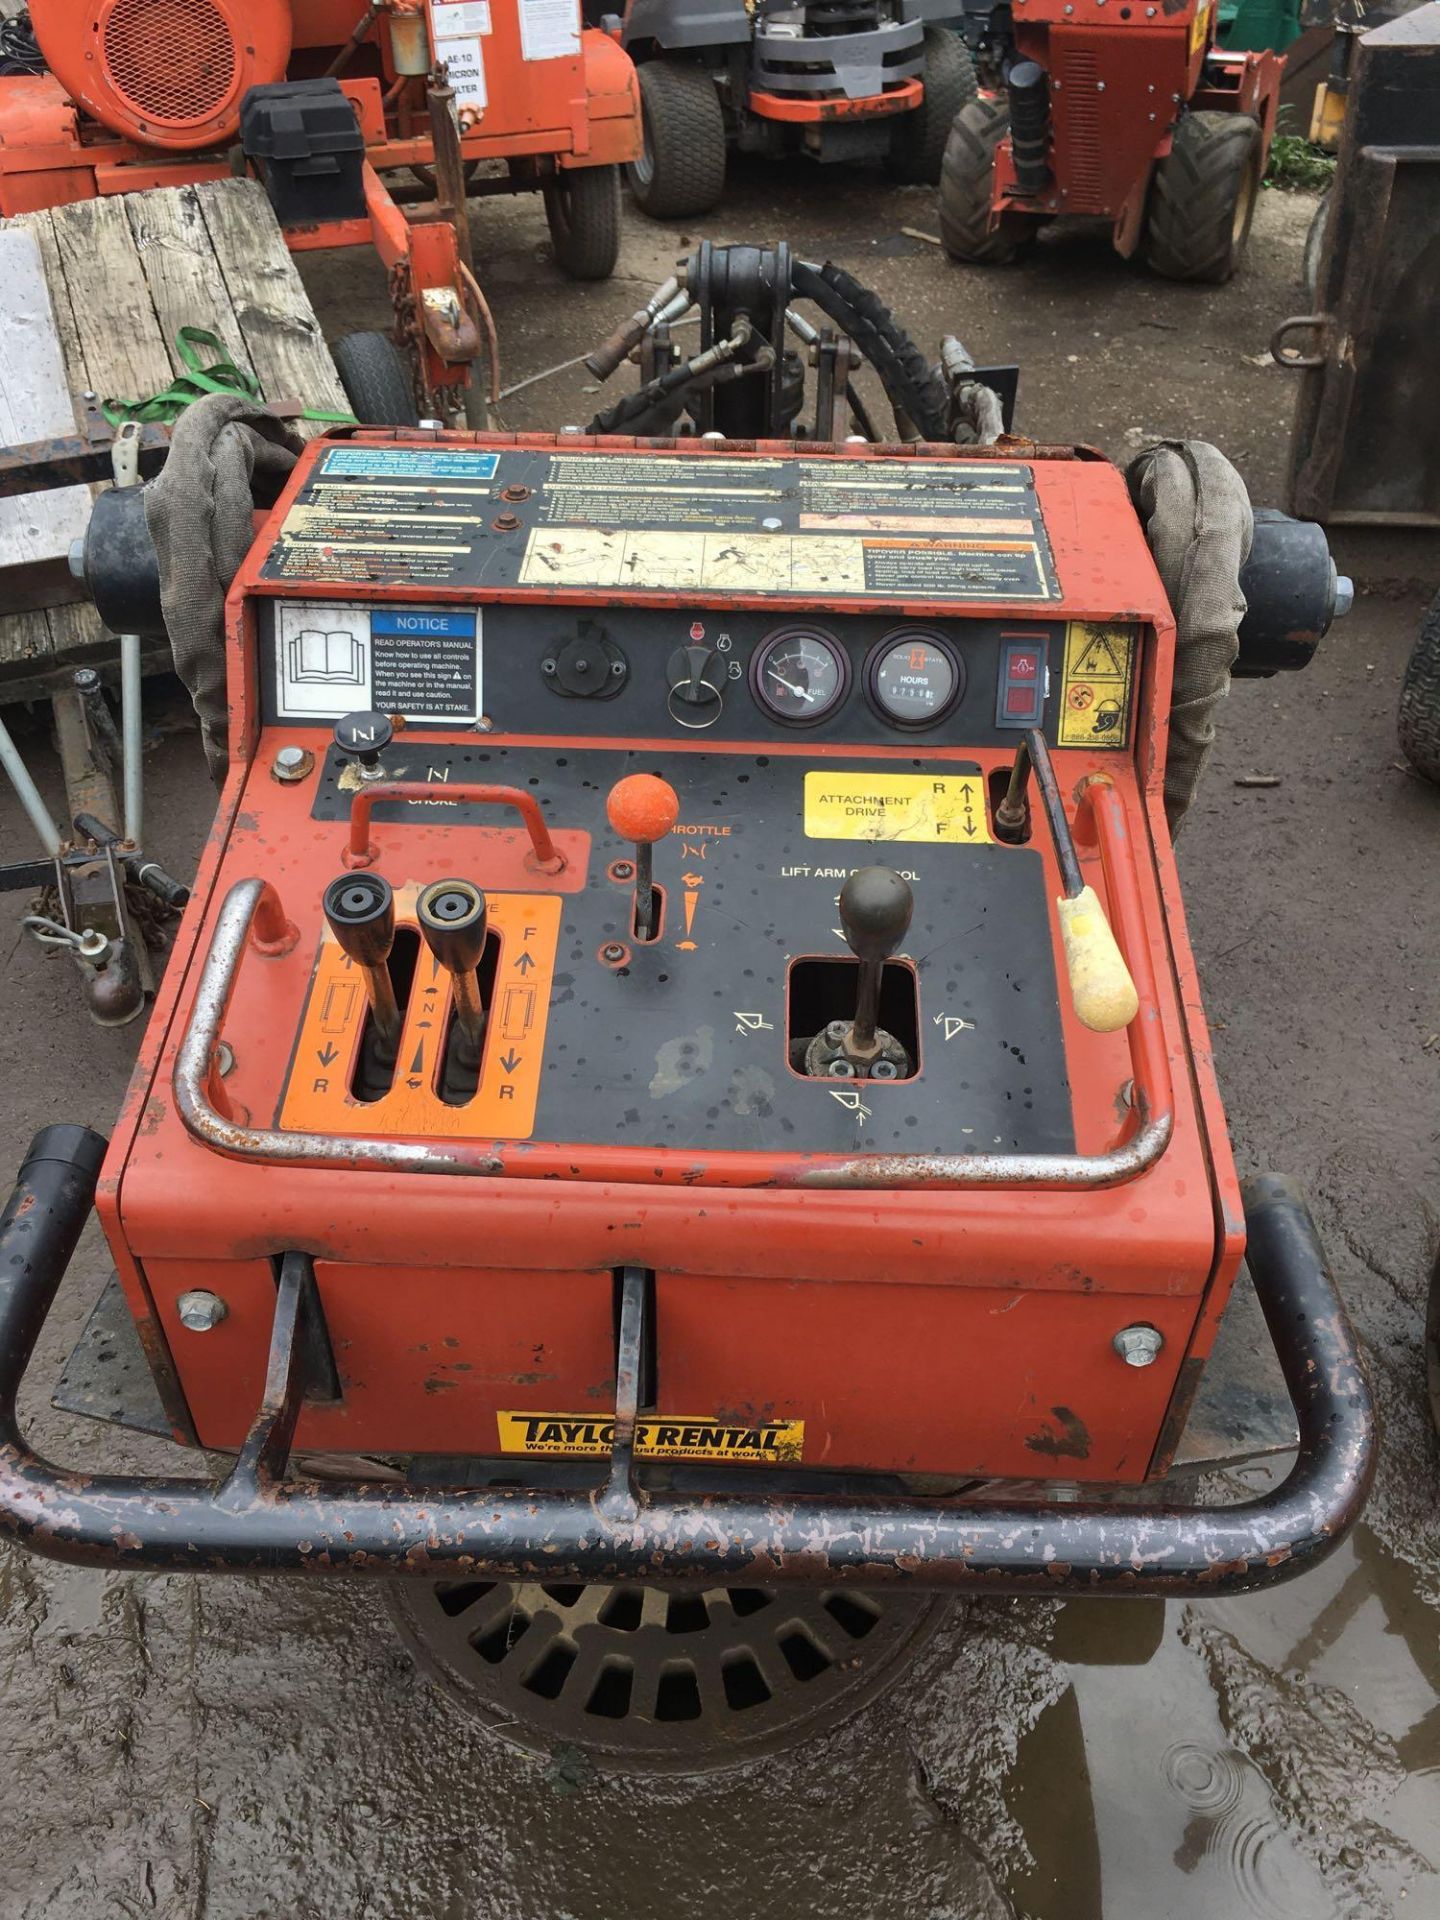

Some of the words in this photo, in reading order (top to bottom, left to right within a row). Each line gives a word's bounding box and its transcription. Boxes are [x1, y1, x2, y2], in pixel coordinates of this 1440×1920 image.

[919, 541, 986, 549] WARNING
[397, 617, 449, 631] NOTICE
[374, 638, 395, 647] READ
[396, 640, 442, 648] OPERATOR'S
[398, 662, 430, 670] operating
[432, 662, 462, 670] machine.
[437, 672, 452, 681] sign
[900, 676, 930, 686] HOURS
[806, 688, 827, 696] FUEL
[375, 702, 396, 710] YOUR
[397, 702, 425, 710] SAFETY
[932, 782, 946, 794] R
[818, 794, 912, 806] ATTACHMENT
[846, 807, 886, 817] DRIVE
[672, 826, 732, 836] HROTTLE
[936, 823, 948, 835] F
[781, 866, 811, 878] LIFT
[814, 868, 846, 879] ARM
[524, 927, 538, 941] F
[422, 1002, 436, 1014] N
[312, 1078, 329, 1093] R
[498, 1084, 516, 1100] R
[656, 1422, 780, 1450] RENTAL
[656, 1448, 713, 1456] products
